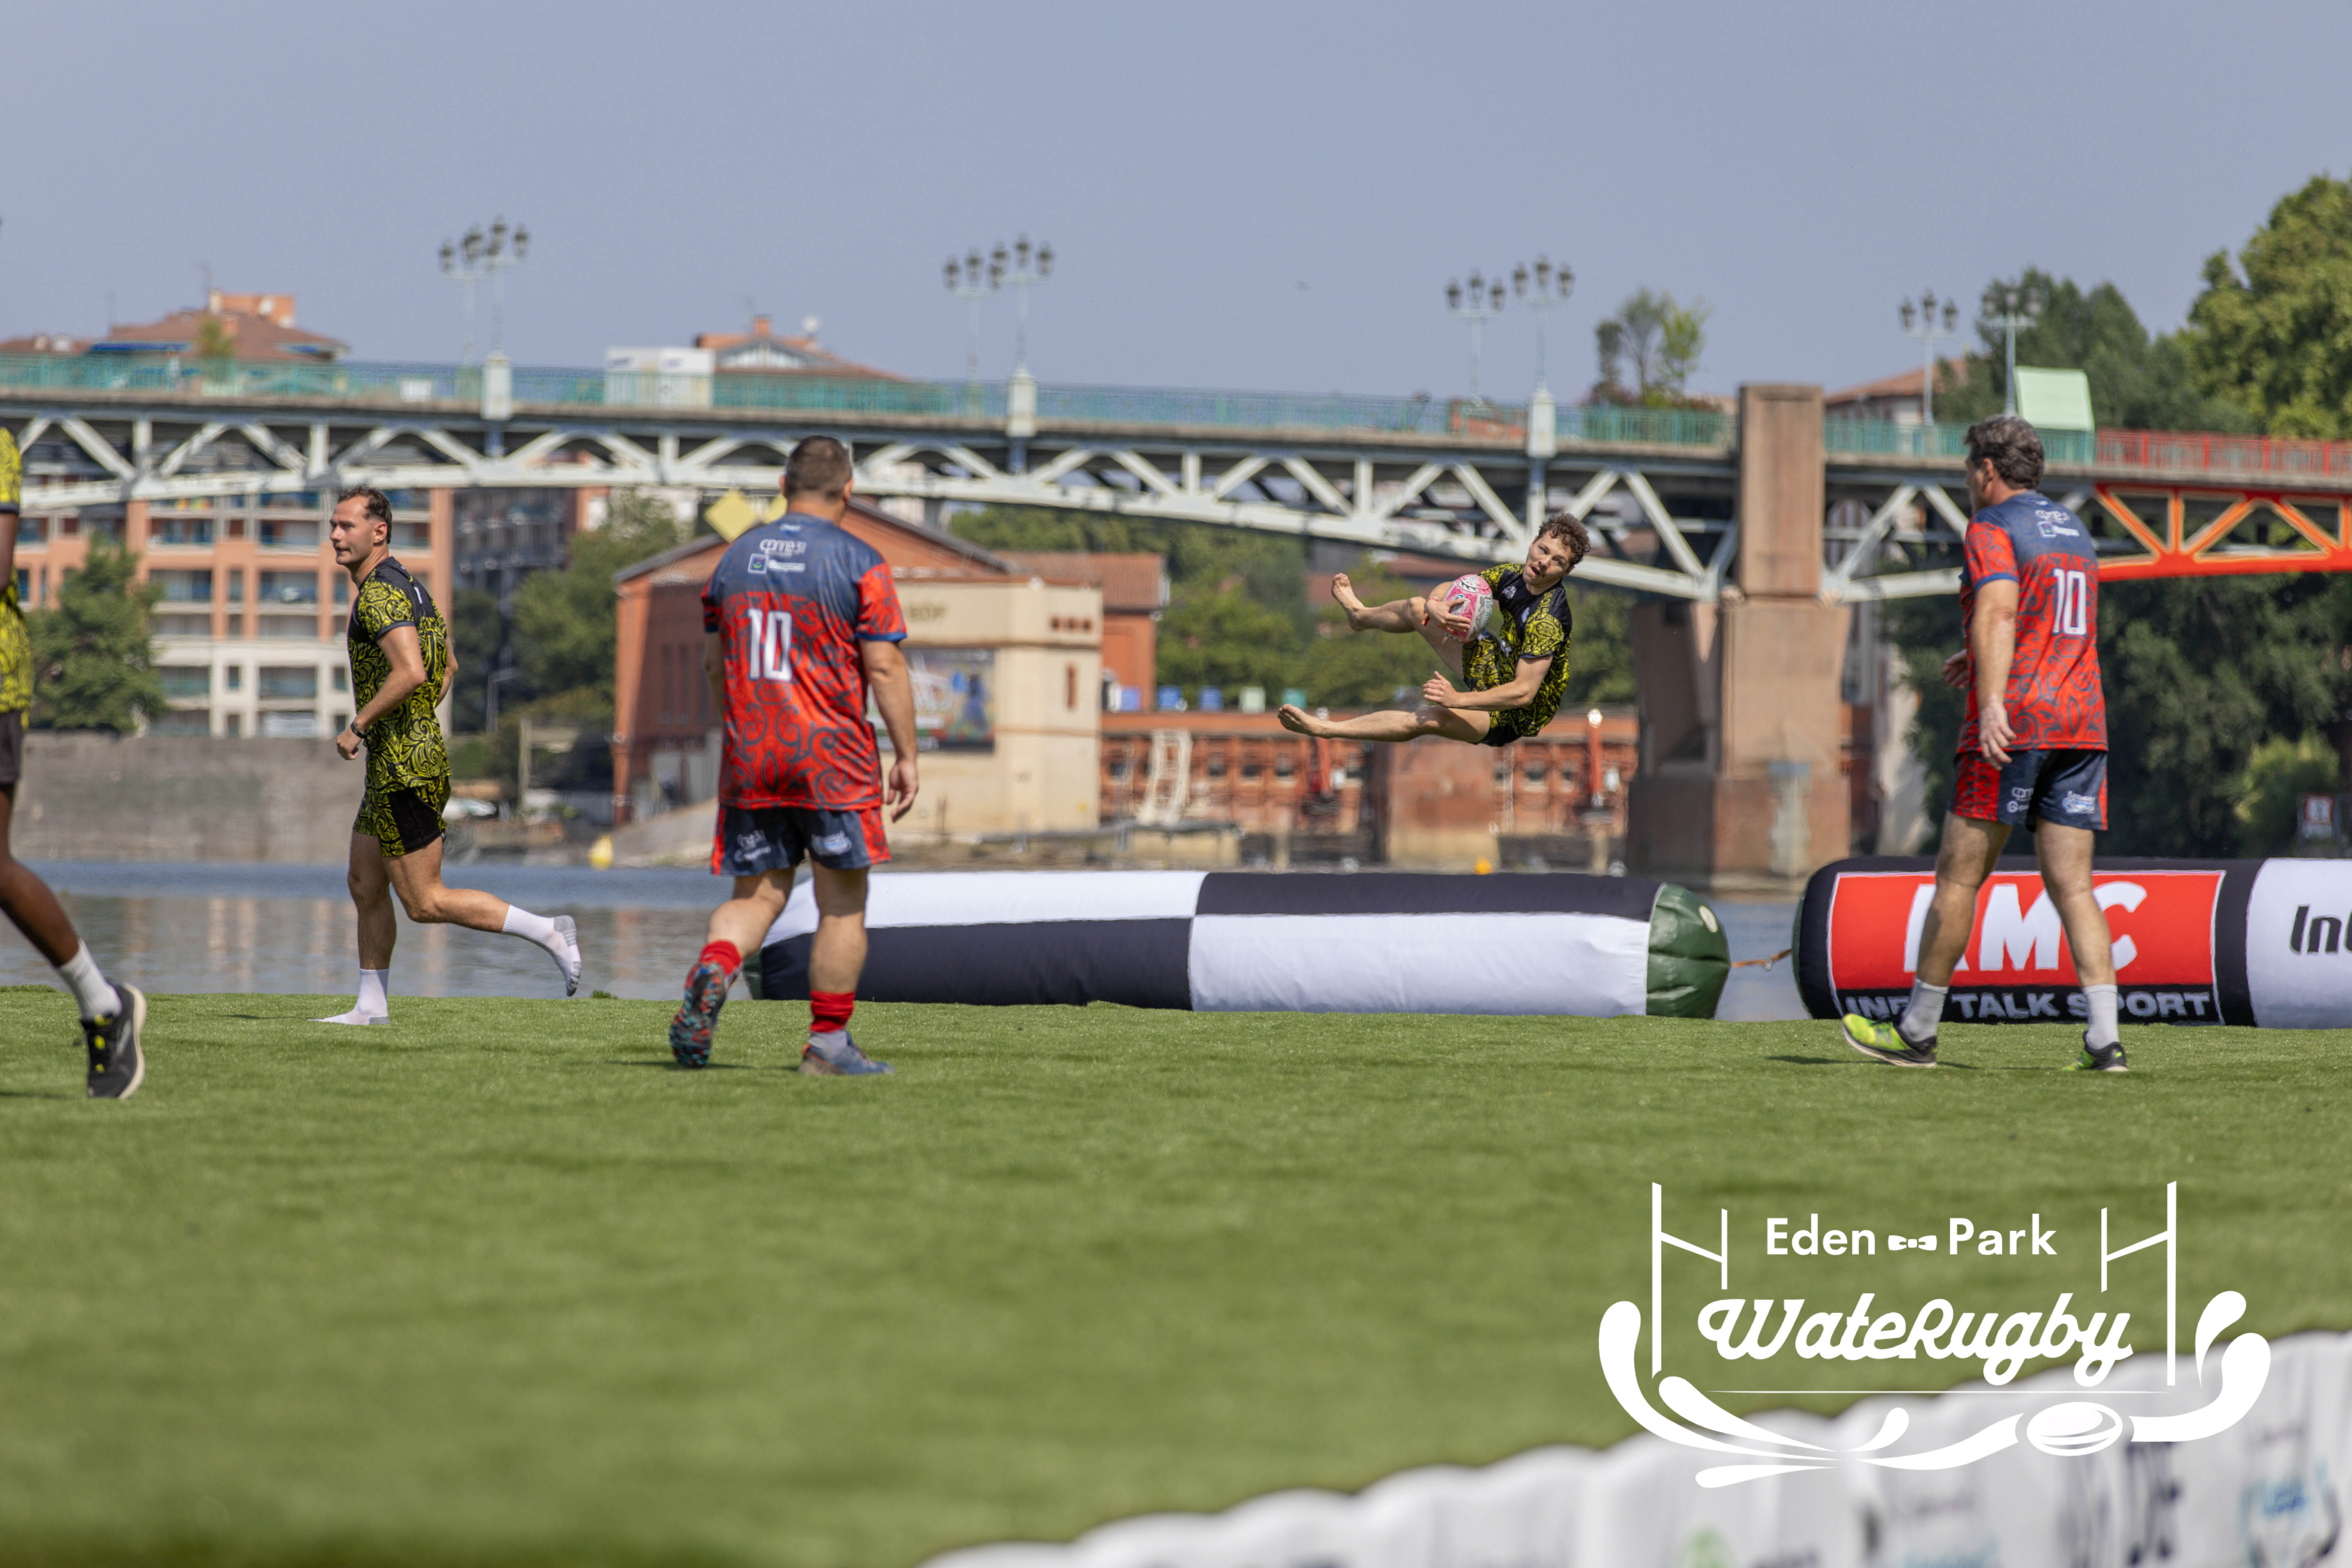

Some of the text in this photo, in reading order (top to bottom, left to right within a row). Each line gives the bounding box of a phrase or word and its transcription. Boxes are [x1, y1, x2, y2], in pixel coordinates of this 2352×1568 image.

[2052, 568, 2087, 635] 10
[748, 608, 793, 682] 10
[1951, 991, 2060, 1019] TALK
[2066, 991, 2211, 1018] SORT
